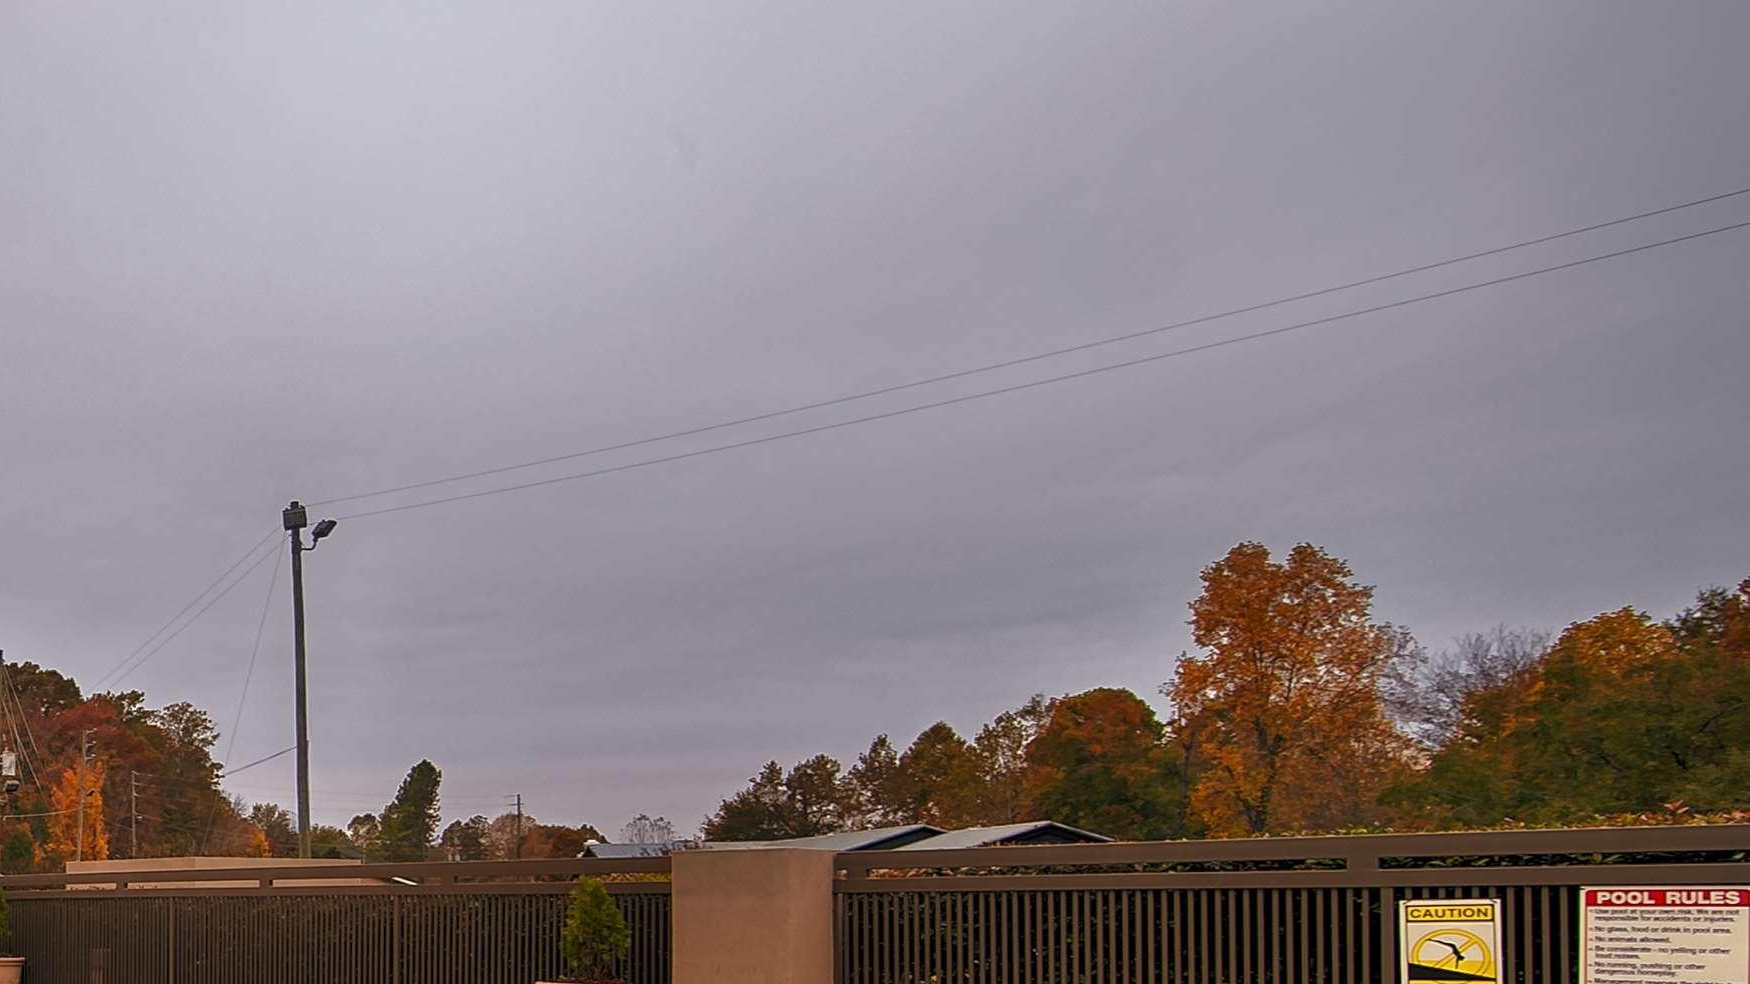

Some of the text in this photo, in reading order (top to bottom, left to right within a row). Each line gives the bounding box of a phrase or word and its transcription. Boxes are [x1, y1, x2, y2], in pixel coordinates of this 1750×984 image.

[1596, 891, 1741, 905] POOL RULES
[1410, 908, 1489, 918] CAUTION
